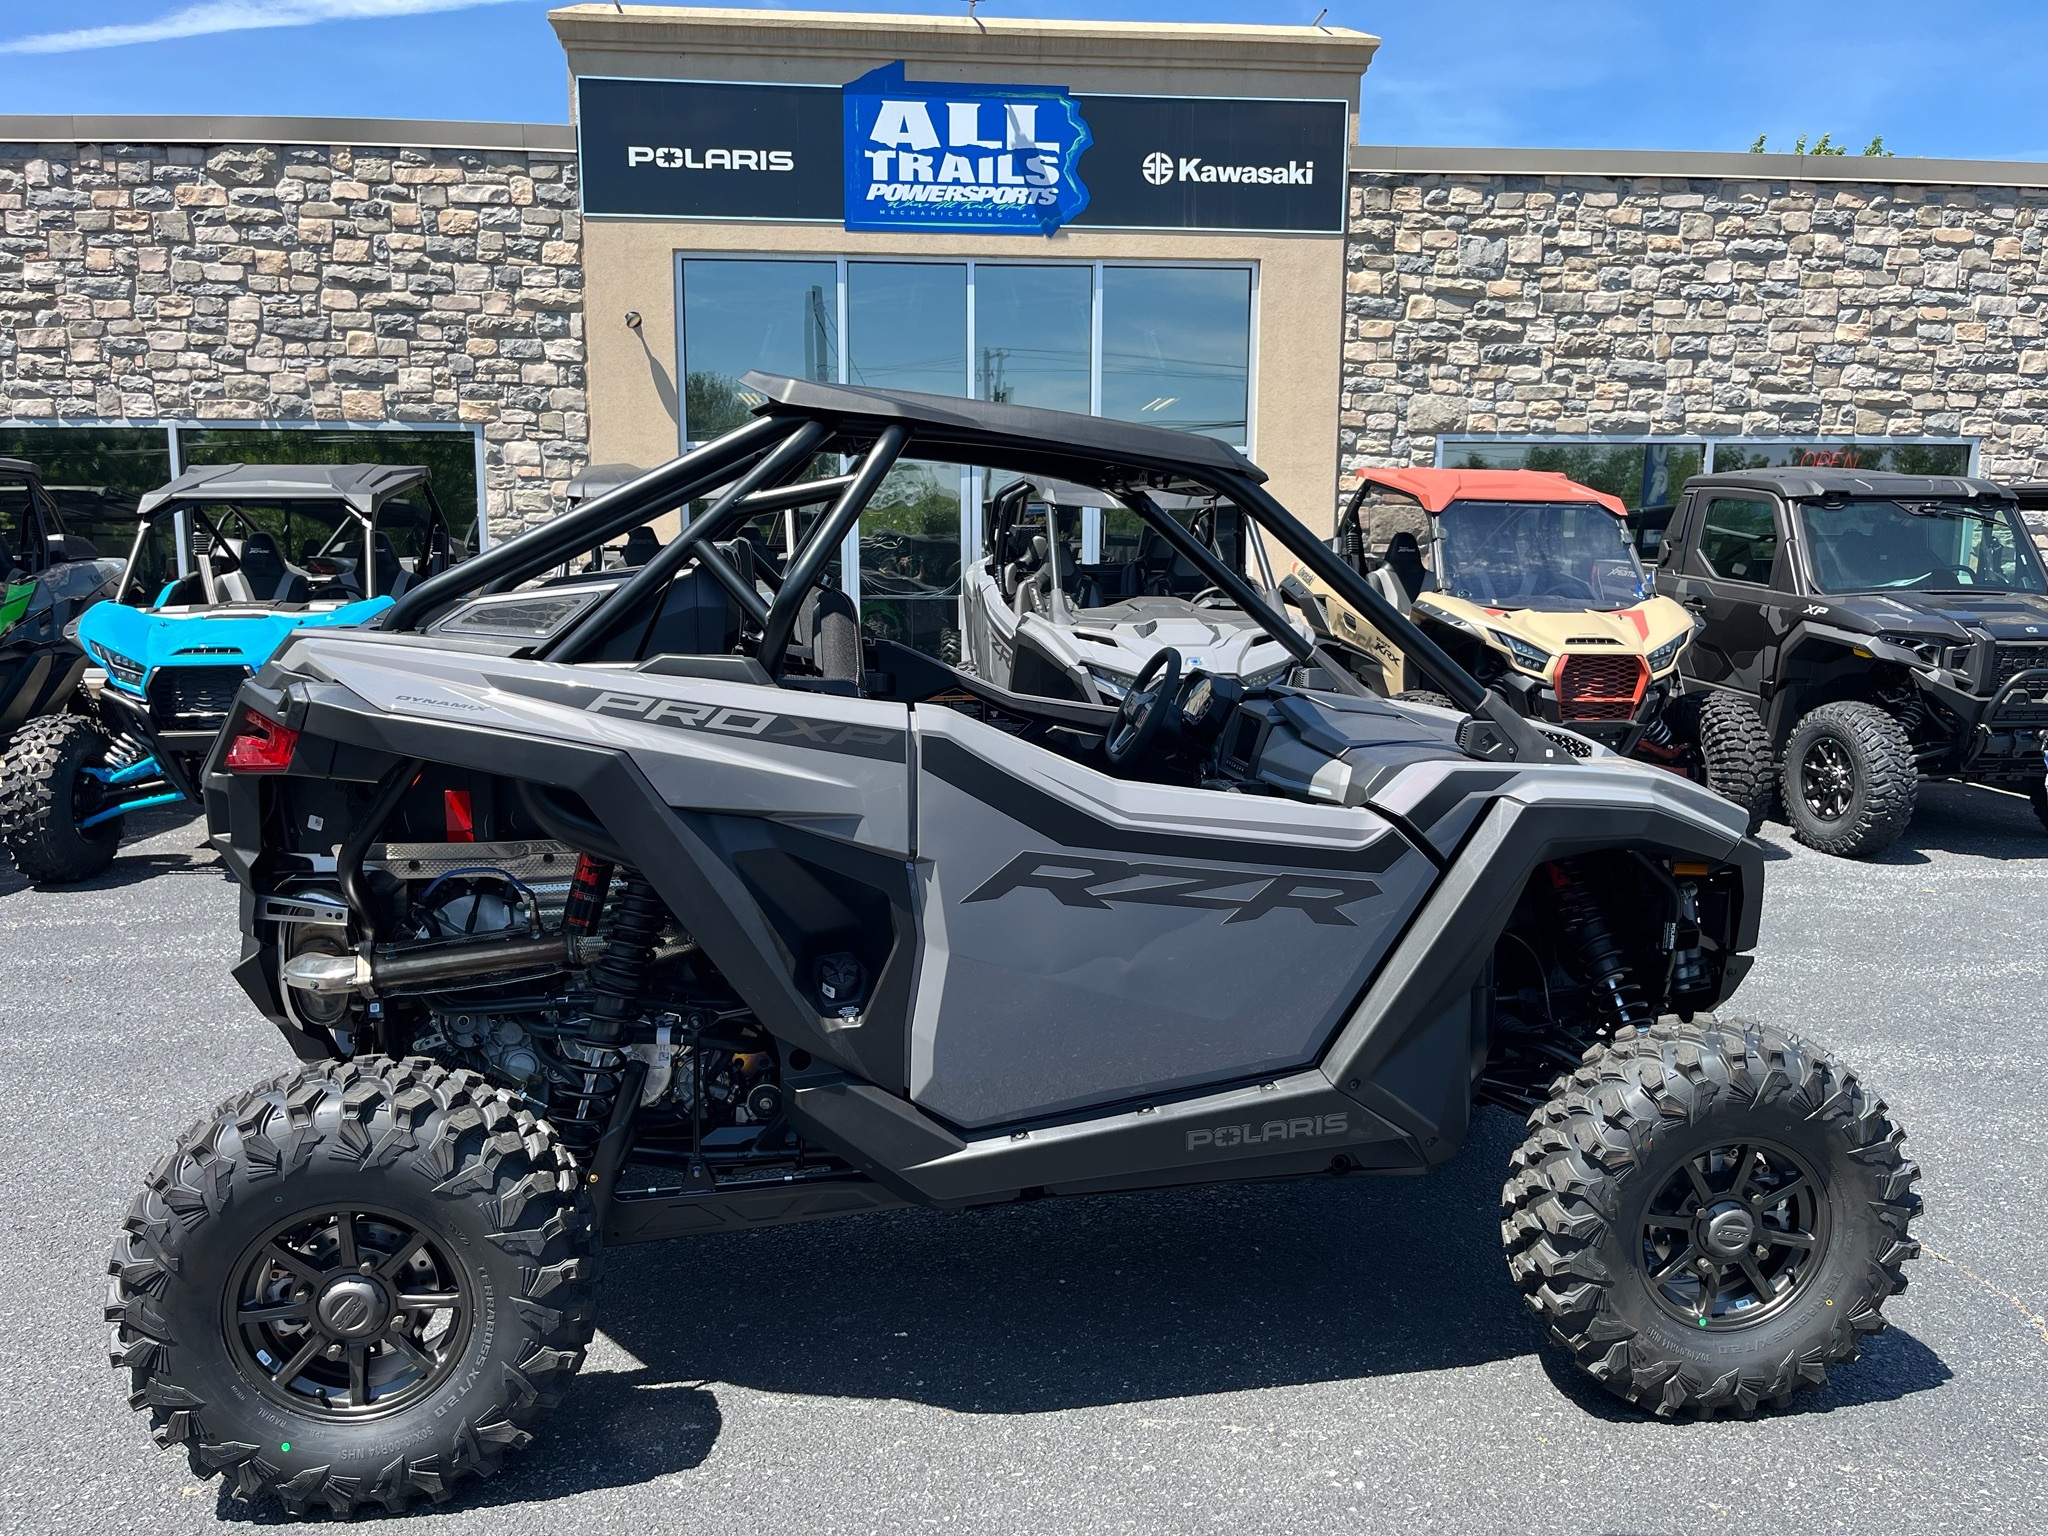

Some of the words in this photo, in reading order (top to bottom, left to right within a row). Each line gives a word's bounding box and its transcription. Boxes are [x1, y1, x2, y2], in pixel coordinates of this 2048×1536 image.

[869, 100, 1060, 153] ALL
[628, 146, 794, 172] POLARIS
[864, 149, 1060, 187] TRAILS
[1178, 157, 1314, 185] Kawasaki
[866, 183, 1059, 206] POWERSPORTS
[1800, 451, 1860, 469] OPEN
[1802, 604, 1829, 616] XP
[394, 694, 492, 712] DYNAMIX
[584, 690, 779, 735] PRO
[777, 717, 898, 745] XP
[957, 849, 1385, 927] RZR
[1186, 1112, 1349, 1151] POLARIS
[257, 1406, 288, 1429] RADIAL
[341, 1448, 366, 1461] NHS
